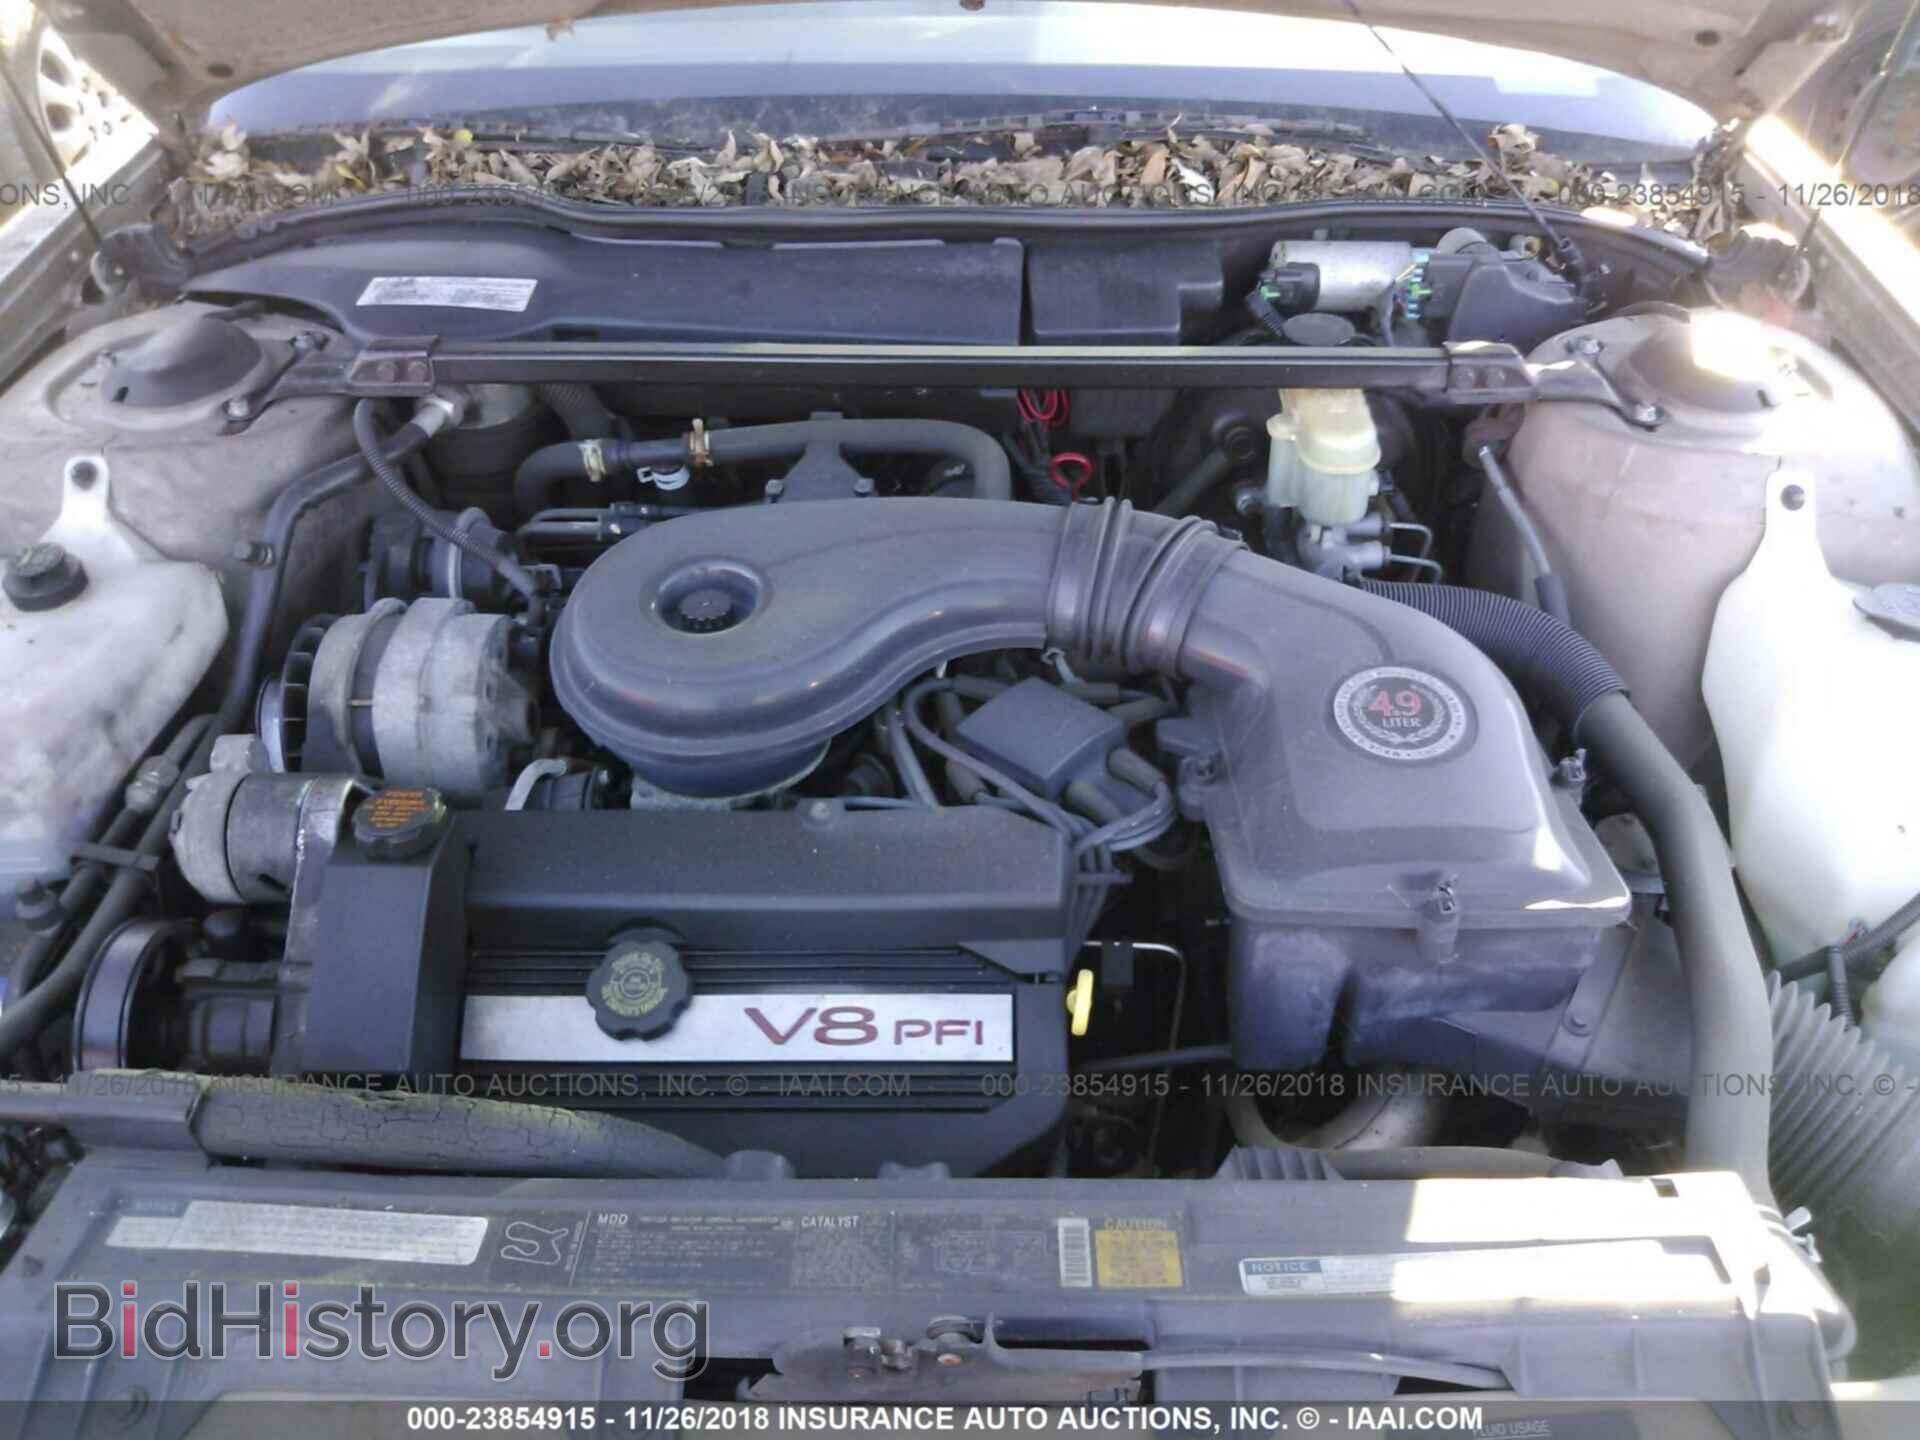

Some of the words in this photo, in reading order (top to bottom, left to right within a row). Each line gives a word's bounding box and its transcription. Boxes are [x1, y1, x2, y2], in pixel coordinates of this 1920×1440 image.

[1382, 717, 1421, 728] LITER
[743, 1006, 879, 1046] V8
[893, 1019, 984, 1046] PFI
[801, 1215, 859, 1228] CATALYST
